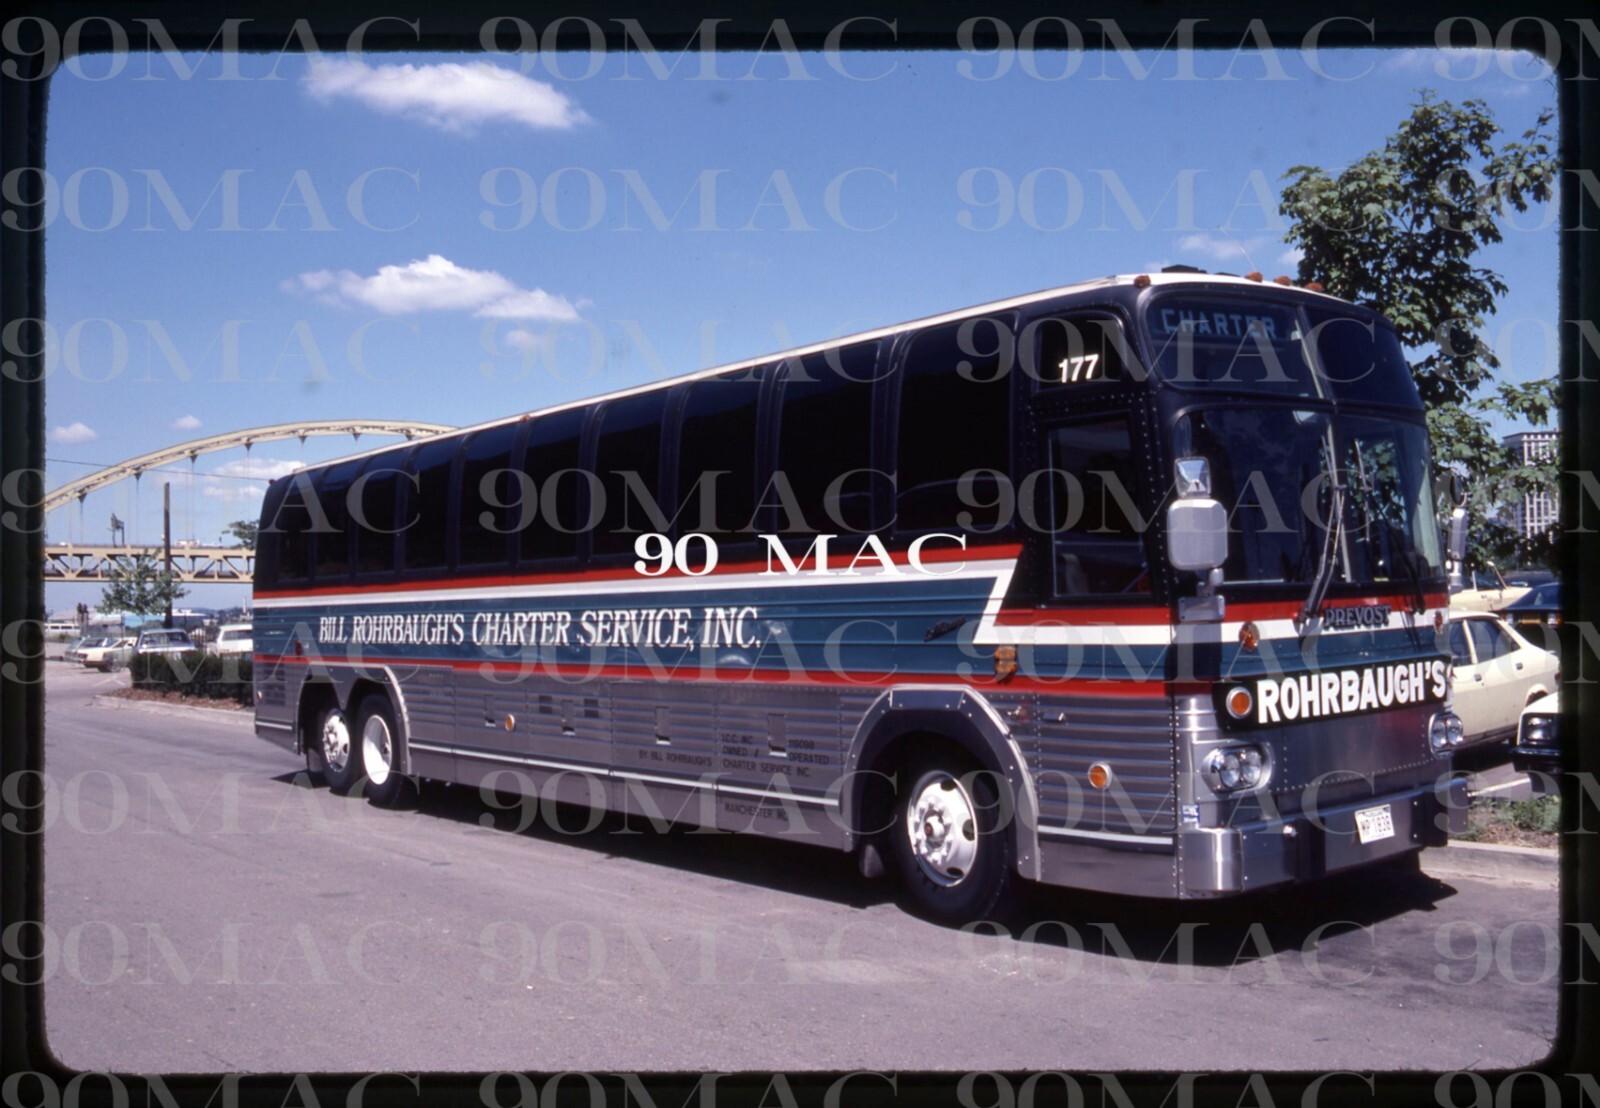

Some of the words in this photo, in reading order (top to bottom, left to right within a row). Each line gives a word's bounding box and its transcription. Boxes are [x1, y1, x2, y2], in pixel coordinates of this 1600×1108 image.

[1161, 308, 1276, 338] CHARTER
[1058, 354, 1099, 384] 177
[318, 615, 348, 643] BILL
[351, 613, 466, 645] ROHRBAUGH'S
[472, 610, 571, 646] CHARTER
[576, 607, 695, 652] SERVICE,
[702, 606, 761, 648] INC.
[1323, 605, 1392, 630] PREVOST
[1257, 659, 1447, 725] ROHRBAUGH'S
[722, 745, 748, 757] OWNED
[788, 752, 830, 765] OPERATED
[723, 759, 756, 771] CHARTER
[760, 762, 792, 776] SERVICE
[725, 802, 773, 819] MANCHESTER
